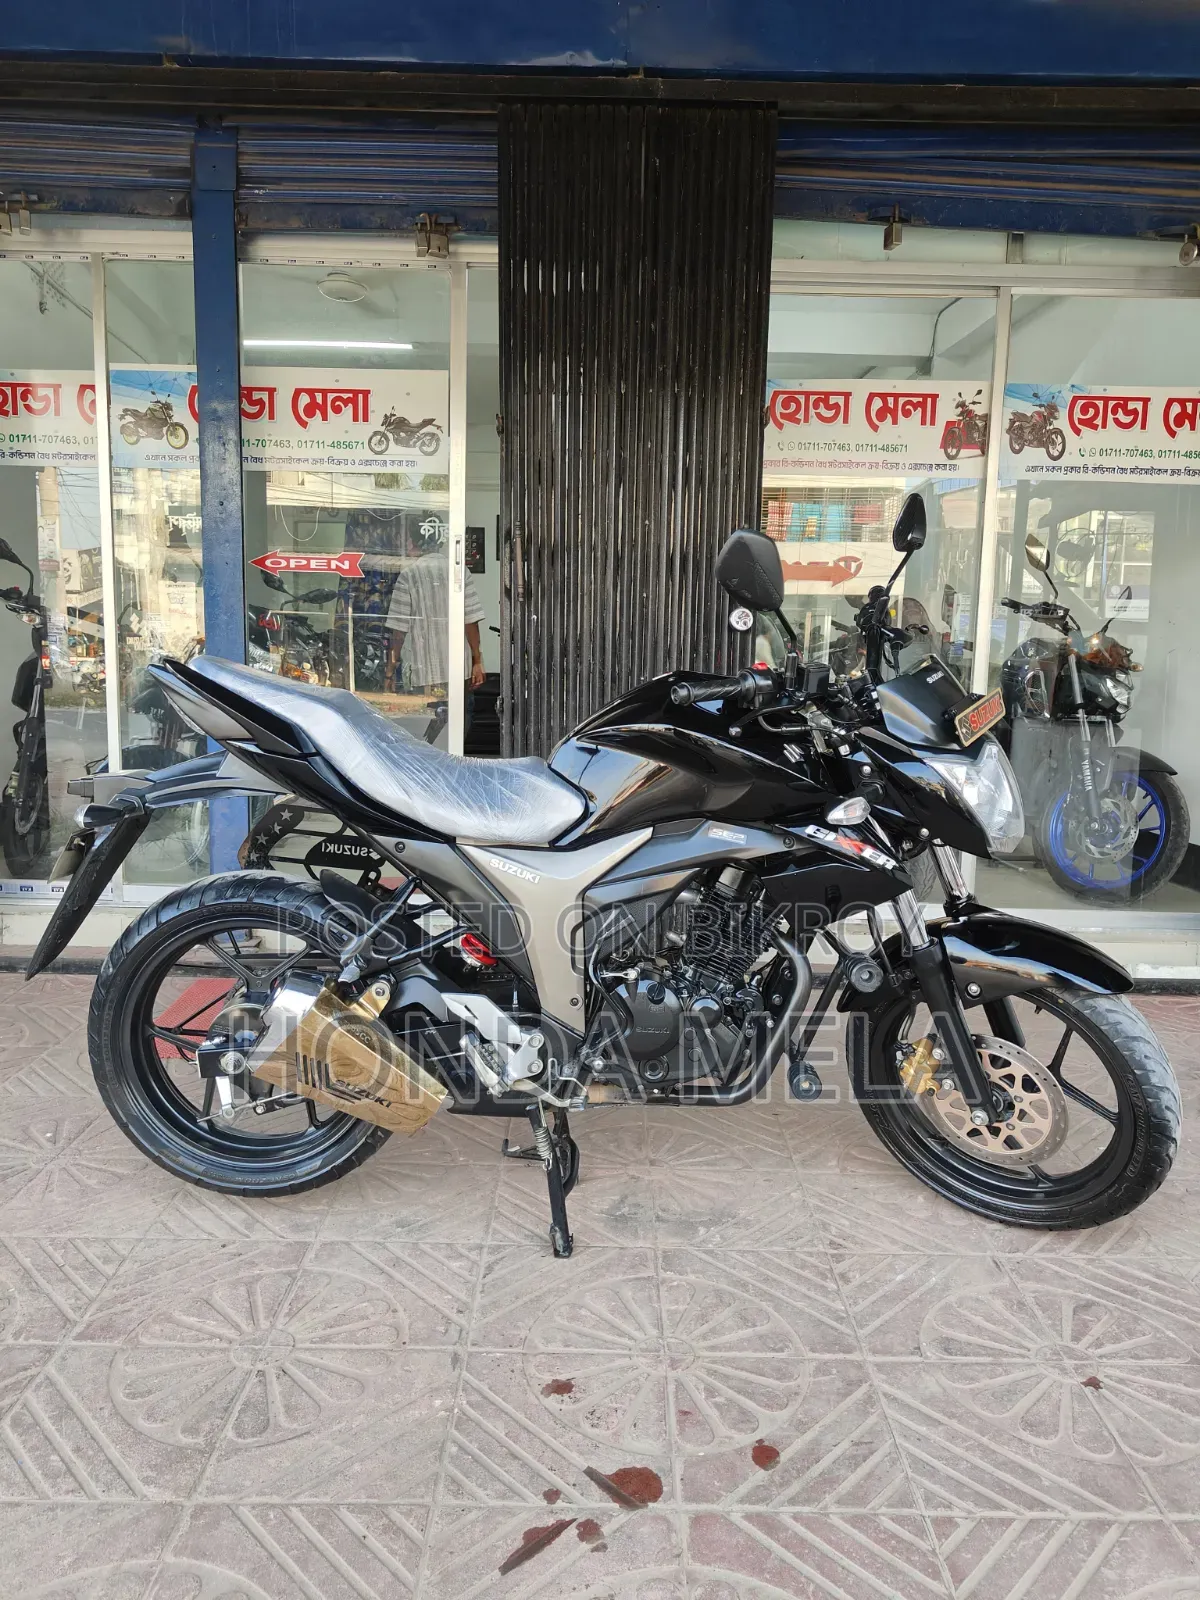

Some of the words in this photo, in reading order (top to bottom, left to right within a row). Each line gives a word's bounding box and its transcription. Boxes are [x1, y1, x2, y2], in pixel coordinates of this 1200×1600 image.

[291, 387, 371, 430] মেলা
[865, 391, 940, 433] মেলা
[1162, 396, 1200, 439] মে
[242, 438, 294, 450] 11-707463,
[297, 439, 366, 450] 01711-485671
[797, 441, 853, 453] 01711-707463,
[855, 442, 909, 453] 01711-485671
[1098, 447, 1156, 459] 01711-707463,
[1157, 449, 1200, 460] 01711-4856
[264, 557, 350, 570] OPEN
[969, 695, 1002, 731] SUZUKI
[1081, 759, 1093, 792] YAMAHA
[489, 858, 541, 884] SUZUKI
[336, 1079, 392, 1108] SUZUKI
